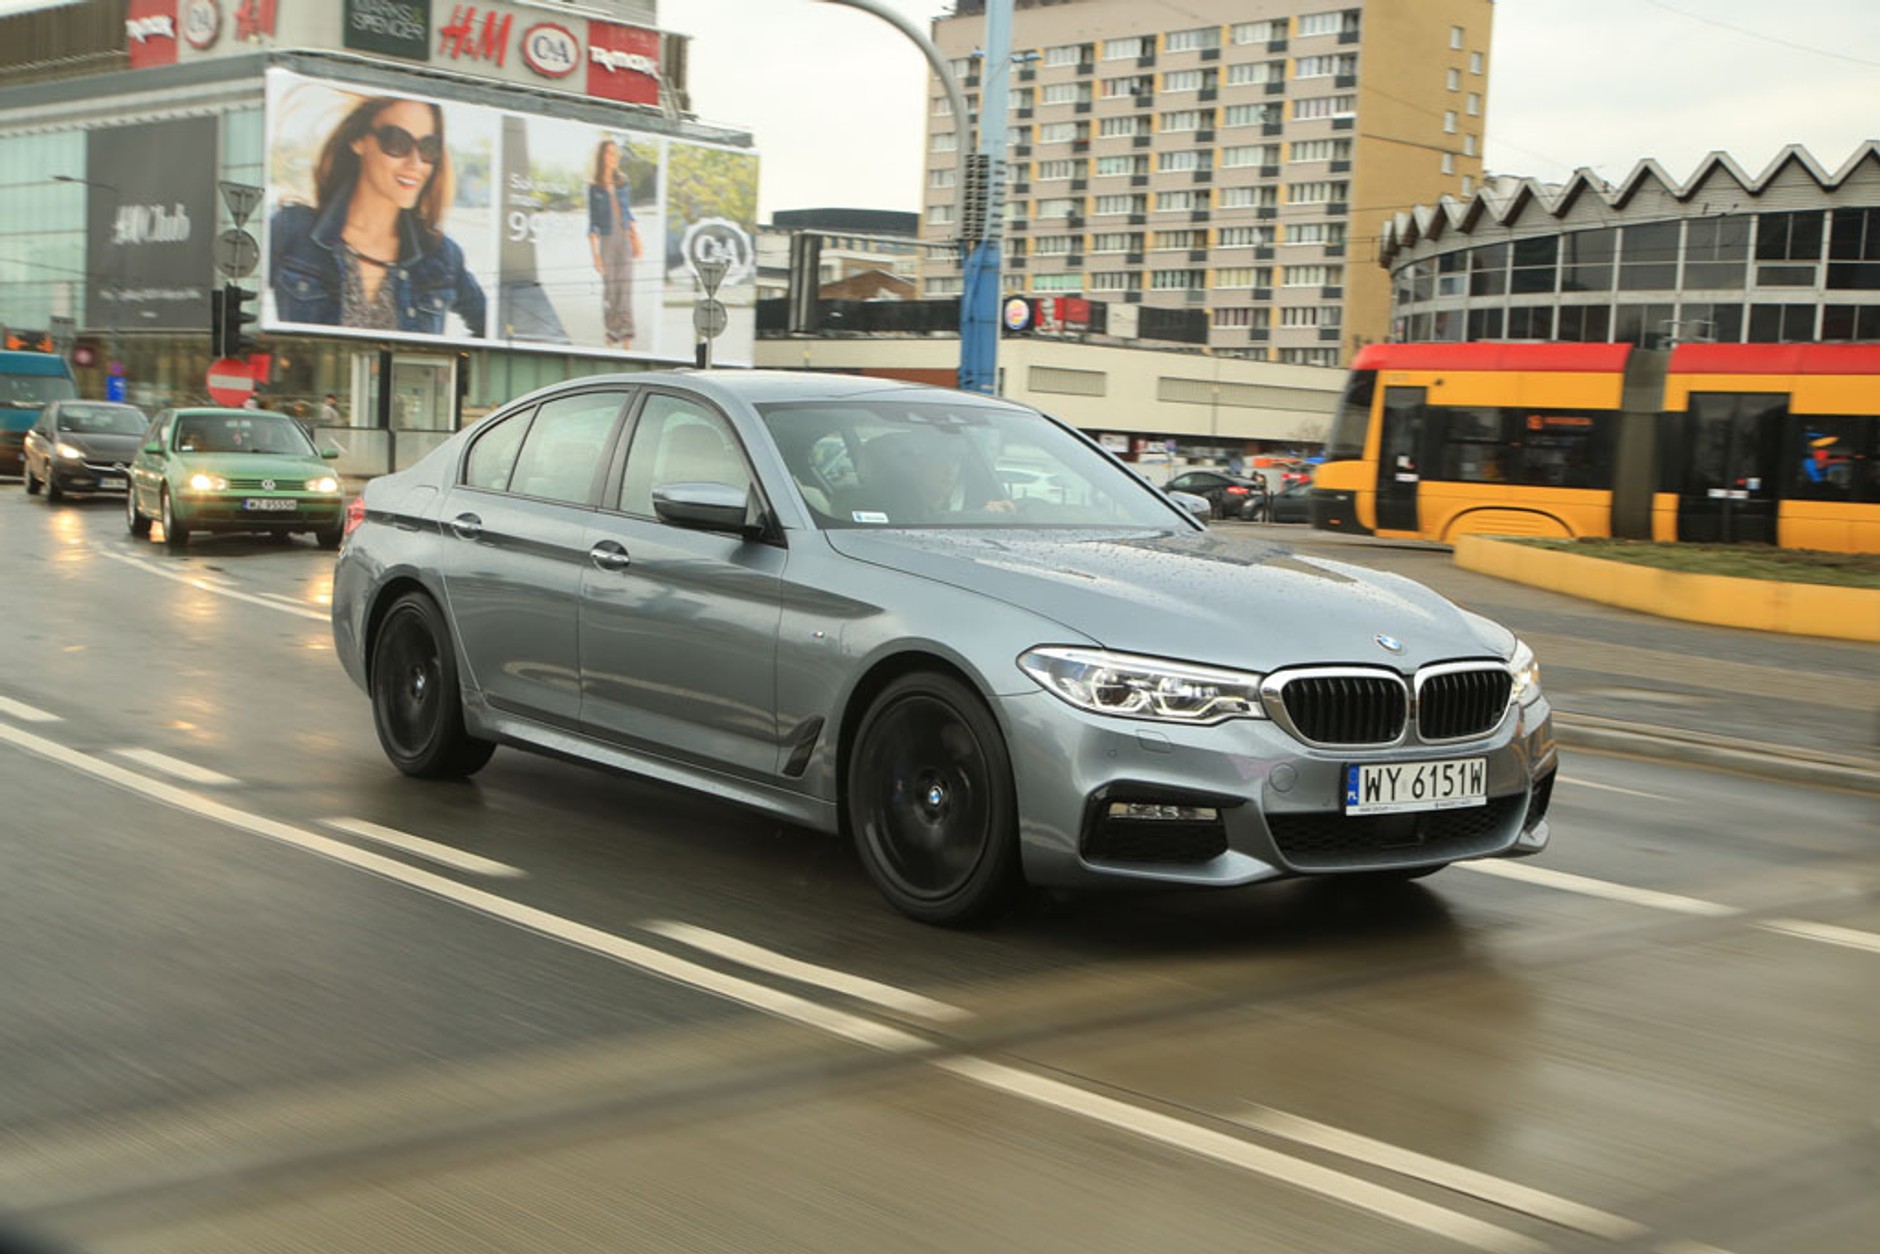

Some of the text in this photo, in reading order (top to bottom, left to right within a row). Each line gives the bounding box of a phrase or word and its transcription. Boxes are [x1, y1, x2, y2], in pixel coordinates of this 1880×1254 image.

[351, 11, 426, 41] SPENCER
[437, 3, 514, 69] H&M
[1364, 761, 1483, 802] WY 6151W
